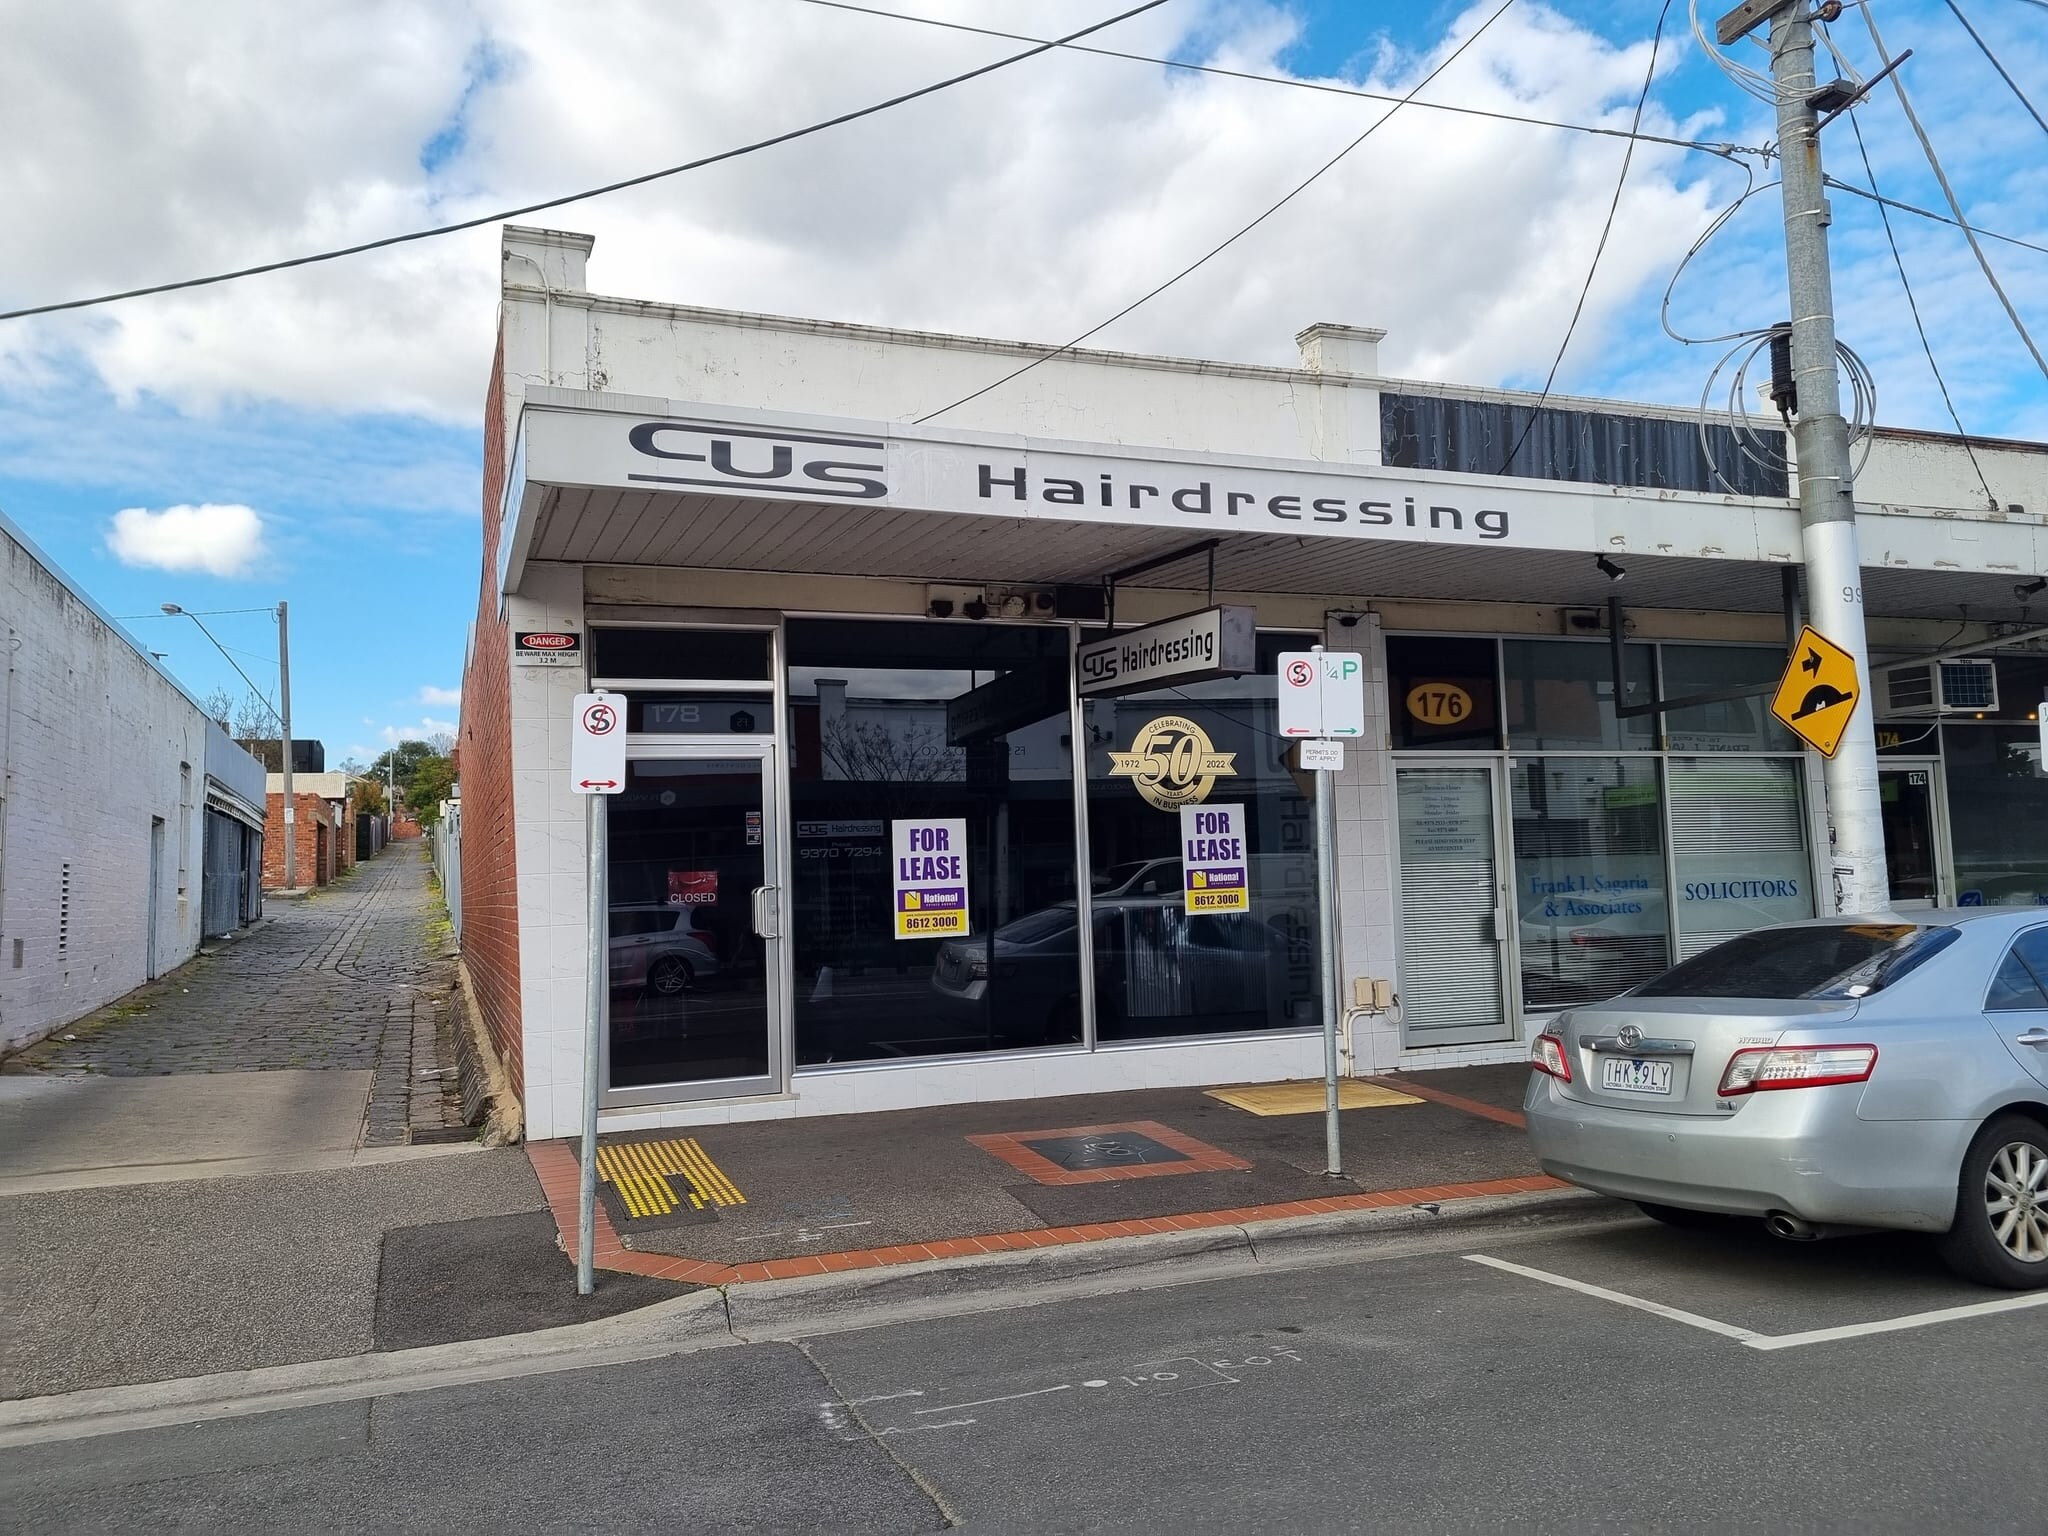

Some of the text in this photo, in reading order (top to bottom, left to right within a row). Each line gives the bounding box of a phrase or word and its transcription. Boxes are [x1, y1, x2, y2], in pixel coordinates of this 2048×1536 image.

[628, 422, 1509, 539] CUS Hairdressing
[529, 636, 567, 646] DANGER
[538, 657, 549, 665] 3.2
[541, 650, 557, 658] MAX
[557, 650, 578, 659] HEIGHT
[1082, 629, 1214, 685] CUS Hairdressing
[1416, 691, 1463, 719] 176
[651, 704, 701, 724] 178
[1148, 719, 1197, 734] CELEBRATING
[1877, 731, 1901, 748] 174
[1120, 760, 1140, 768] 1972
[1137, 733, 1203, 786] 50
[1206, 760, 1226, 768] 2022
[1909, 773, 1926, 785] 174
[1152, 796, 1163, 806] IN
[831, 822, 882, 836] Hairdressing
[1195, 811, 1230, 835] FOR
[909, 827, 950, 852] FOR
[800, 845, 882, 860] 9370 7294
[1187, 838, 1241, 862] LEASE
[899, 855, 961, 882] LEASE
[1208, 872, 1239, 883] National
[1530, 875, 1578, 894] Frank
[1594, 873, 1649, 899] Sagaria
[1684, 878, 1798, 901] SOLICITORS
[670, 892, 716, 904] CLOSED
[923, 892, 958, 904] National
[1194, 893, 1239, 906] 8612 3000
[1545, 898, 1643, 919] & Associates
[906, 916, 958, 929] 8612 3000
[1607, 1062, 1670, 1087] 1HK 9LY
